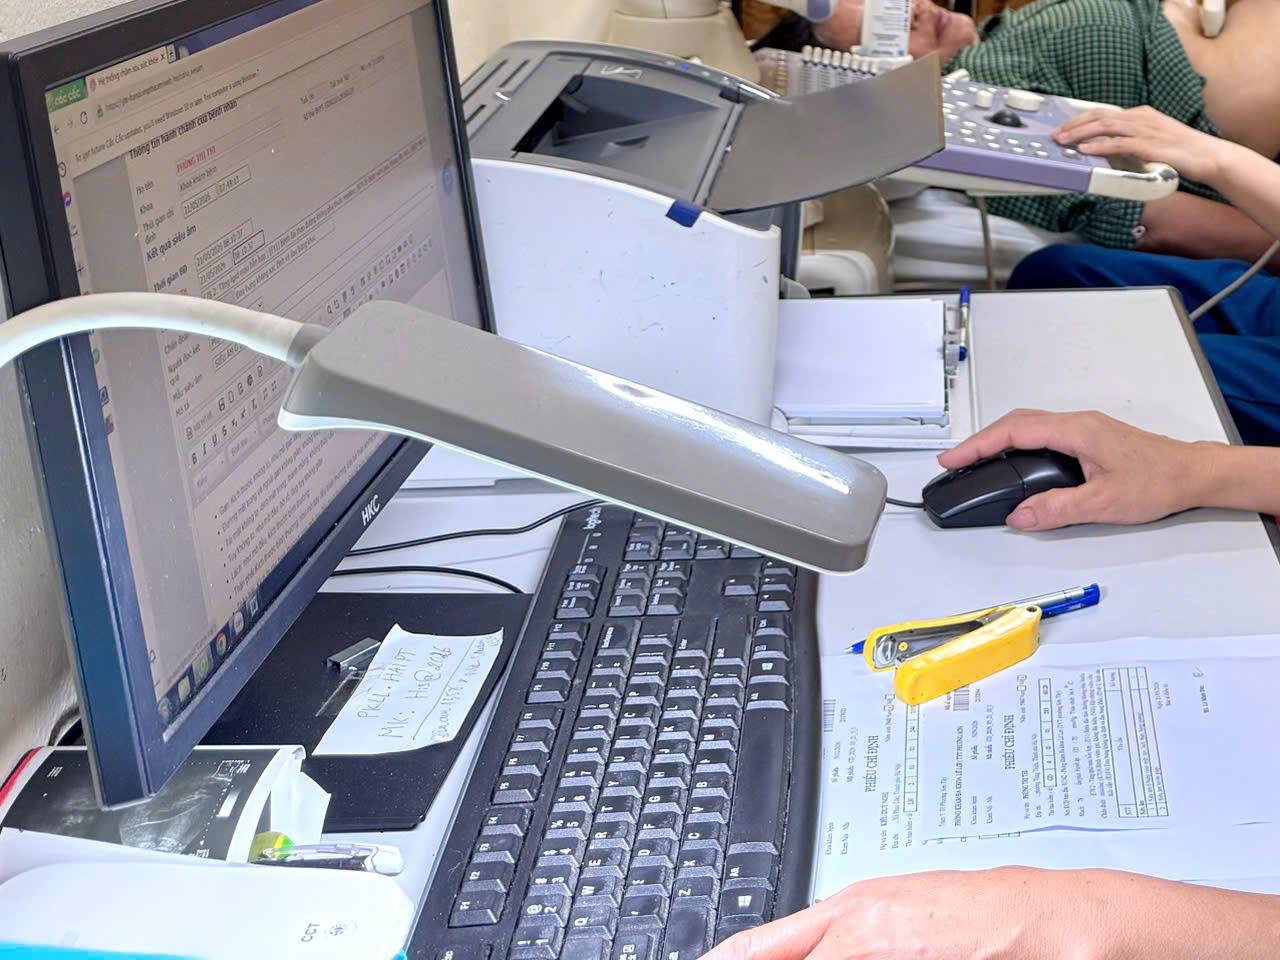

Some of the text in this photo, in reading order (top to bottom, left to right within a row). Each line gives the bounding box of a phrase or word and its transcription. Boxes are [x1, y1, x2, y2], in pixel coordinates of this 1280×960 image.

[129, 142, 151, 160] Thông
[361, 494, 380, 526] HKC
[1002, 715, 1016, 769] PHIẾU CHỈ ĐỊNH
[863, 735, 879, 792] PHIẾU CHỈ ĐỊNH
[601, 805, 613, 813] T
[595, 831, 608, 839] R
[687, 832, 700, 840] C
[559, 847, 572, 855] 4
[638, 848, 651, 856] D
[588, 858, 601, 867] E
[684, 859, 696, 867] X
[470, 871, 480, 880] F2
[552, 876, 564, 884] 3
[581, 885, 595, 896] W
[679, 888, 692, 897] Z
[460, 901, 470, 910] F1
[526, 904, 543, 914] @
[544, 906, 557, 914] 2
[574, 917, 589, 926] Q
[301, 923, 320, 942] CCT
